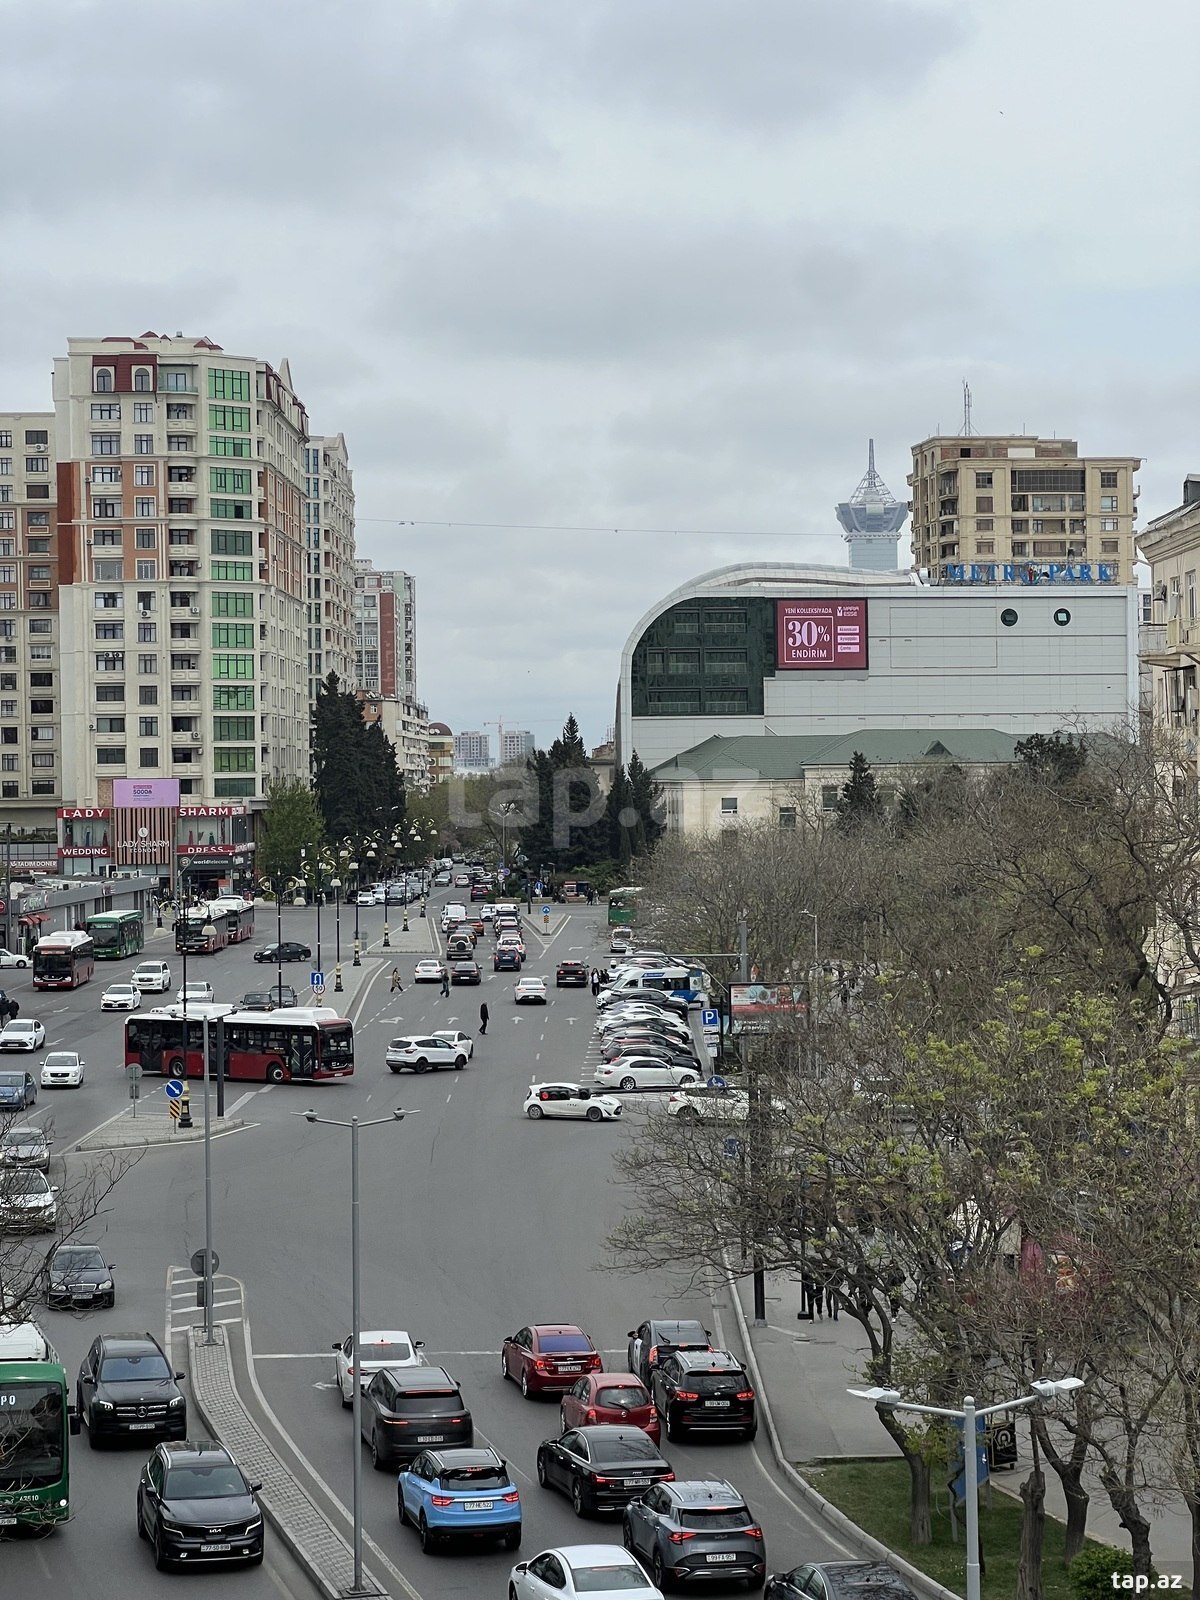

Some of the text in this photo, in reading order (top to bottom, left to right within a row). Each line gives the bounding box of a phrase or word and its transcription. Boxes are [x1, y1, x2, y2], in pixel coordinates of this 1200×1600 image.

[1049, 563, 1112, 582] PARK
[788, 620, 830, 647] 30%
[792, 648, 827, 658] ENDİRİM
[63, 809, 104, 818] LADY
[179, 807, 228, 816] SHARM
[117, 840, 169, 848] LADY SHARM
[705, 1011, 714, 1024] P
